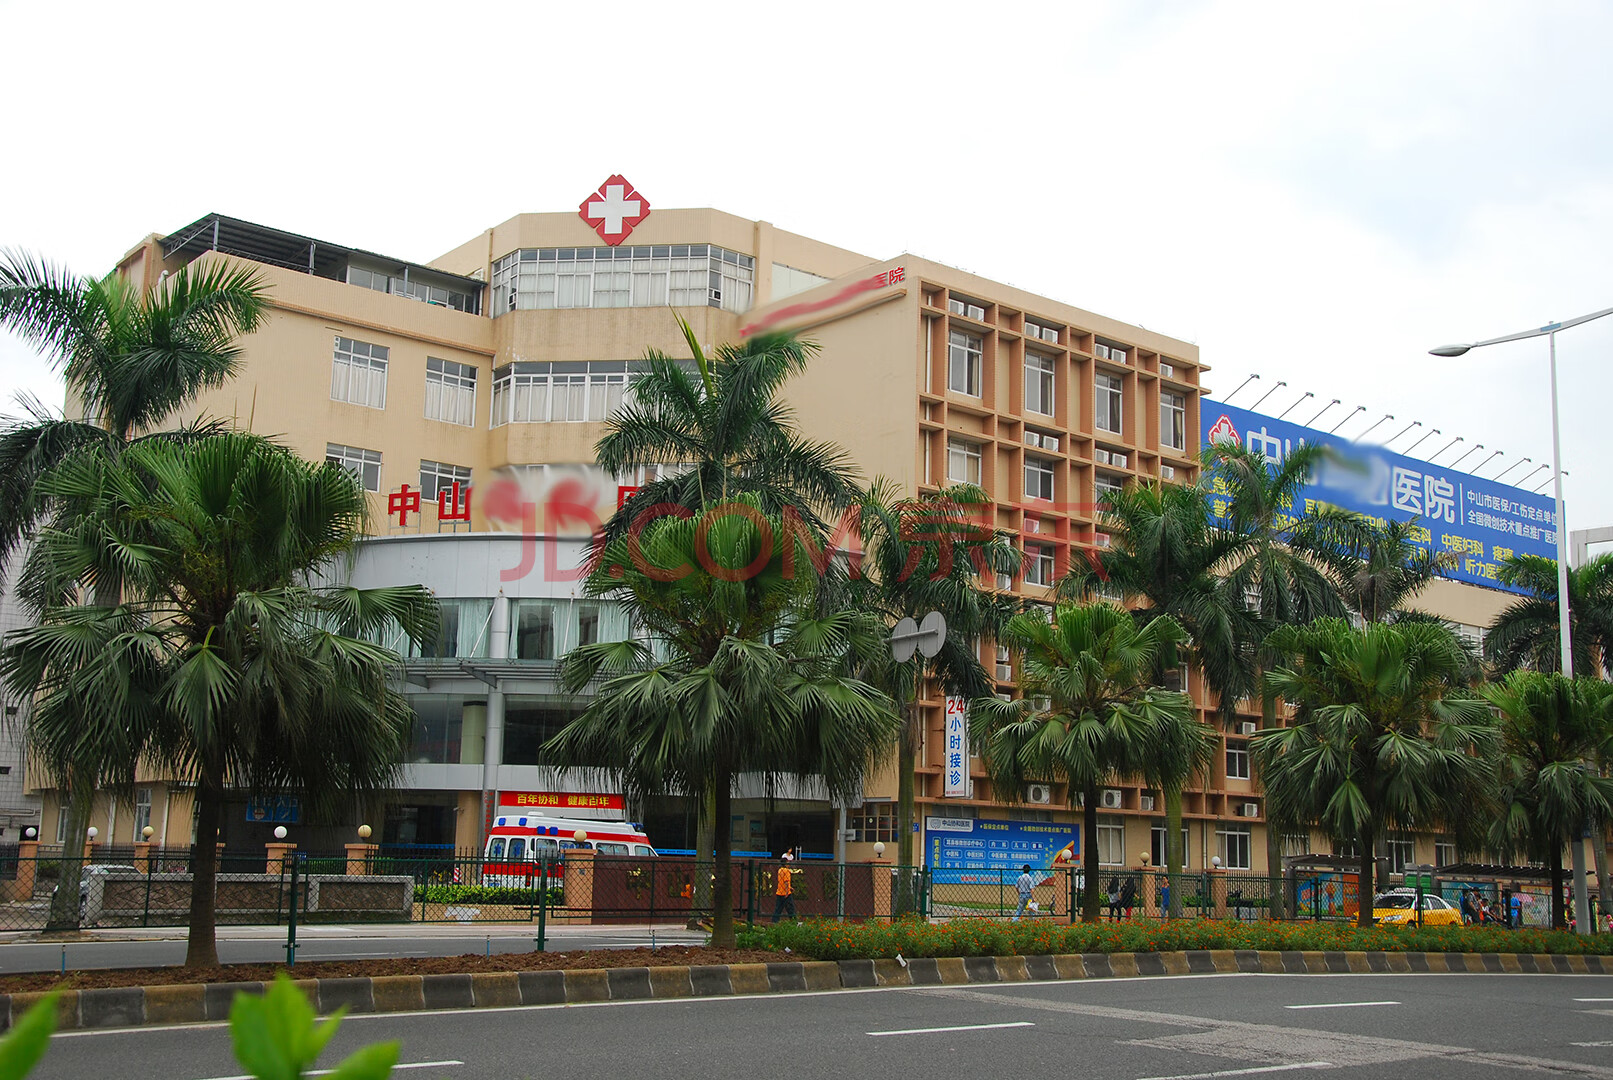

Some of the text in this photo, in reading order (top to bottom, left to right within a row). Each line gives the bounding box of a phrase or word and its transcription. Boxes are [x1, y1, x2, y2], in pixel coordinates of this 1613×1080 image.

[1441, 532, 1484, 558] 中医妇科
[517, 793, 609, 806] 百年协和 健康百年
